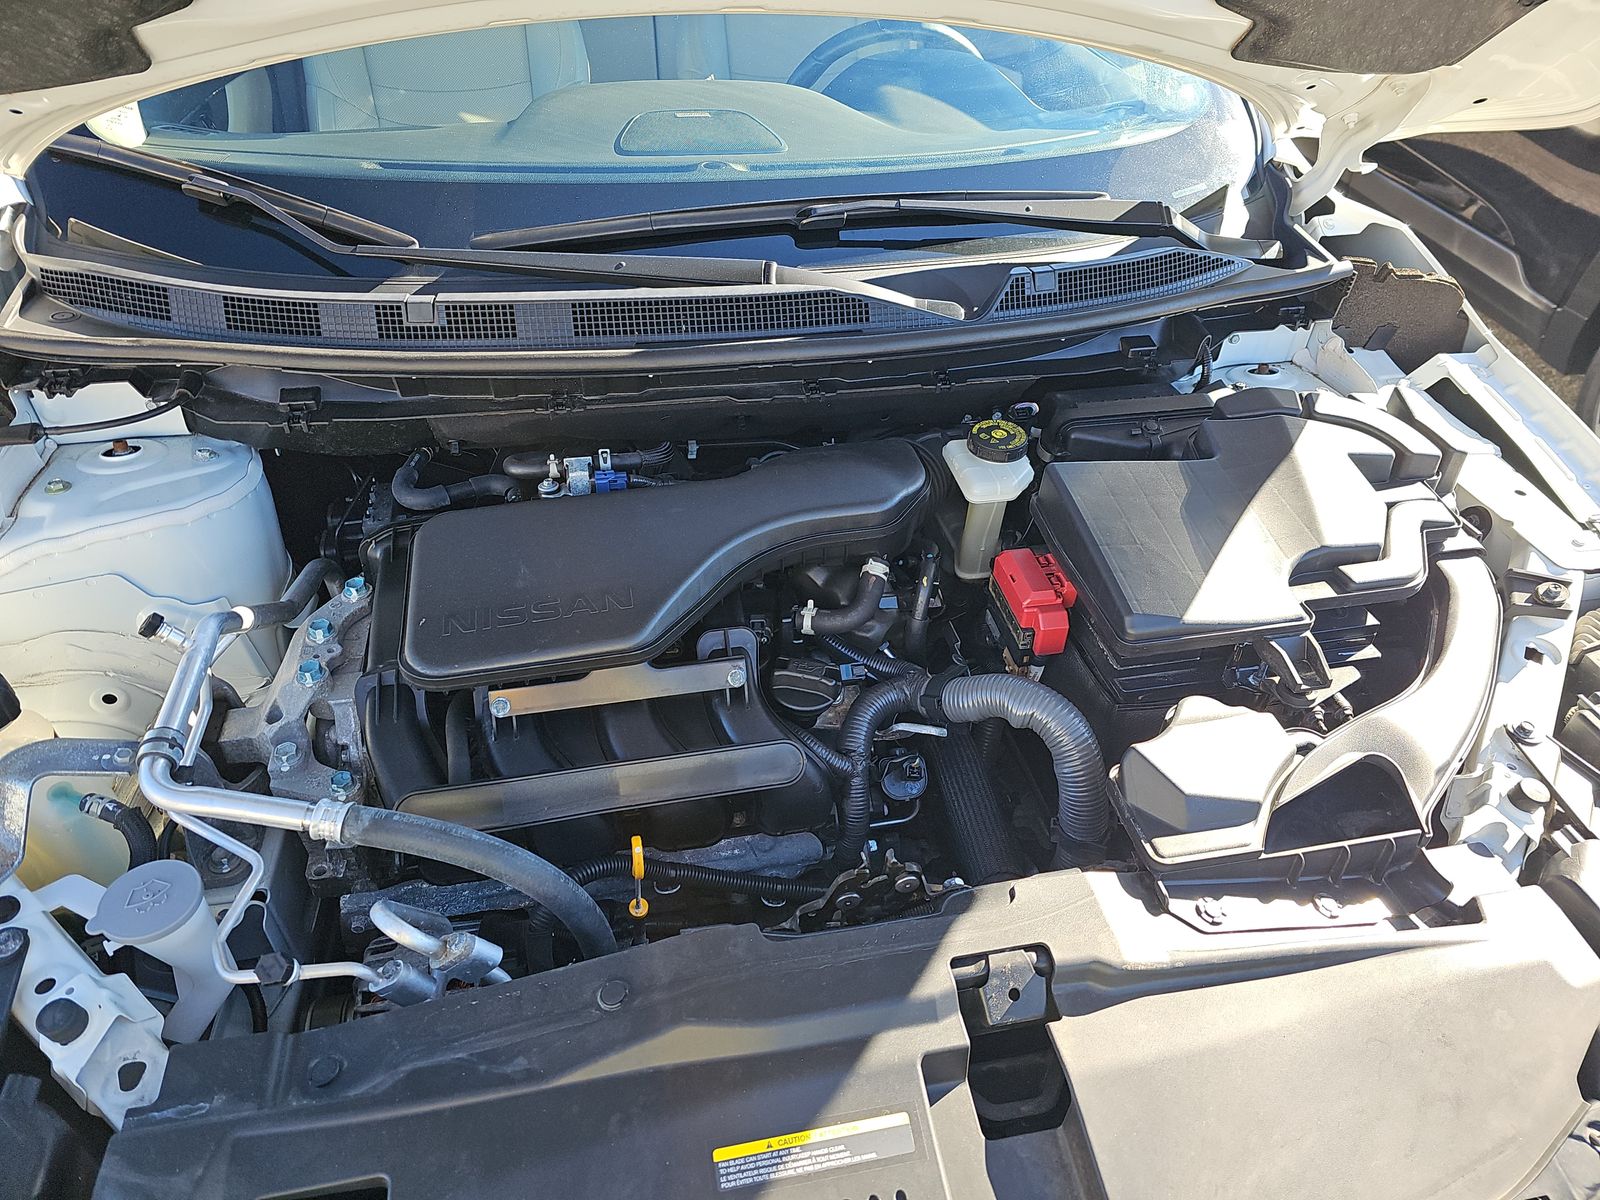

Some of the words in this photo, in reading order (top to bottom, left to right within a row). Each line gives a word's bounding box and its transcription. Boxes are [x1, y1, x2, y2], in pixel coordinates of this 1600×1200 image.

[441, 587, 635, 637] NISSAN
[778, 1134, 811, 1146] CAUTION
[727, 1165, 740, 1173] HELP
[740, 1162, 755, 1171] AVOID
[756, 1157, 782, 1168] PERSONAL
[729, 1158, 745, 1166] BLADE
[746, 1155, 756, 1163] CAN
[756, 1153, 772, 1161] START
[727, 1168, 759, 1180] VENTILATEUR
[759, 1165, 777, 1174] RISQUE
[720, 1180, 736, 1189] POUR
[736, 1177, 754, 1186] ÉVITER
[753, 1174, 770, 1182] TOUTE
